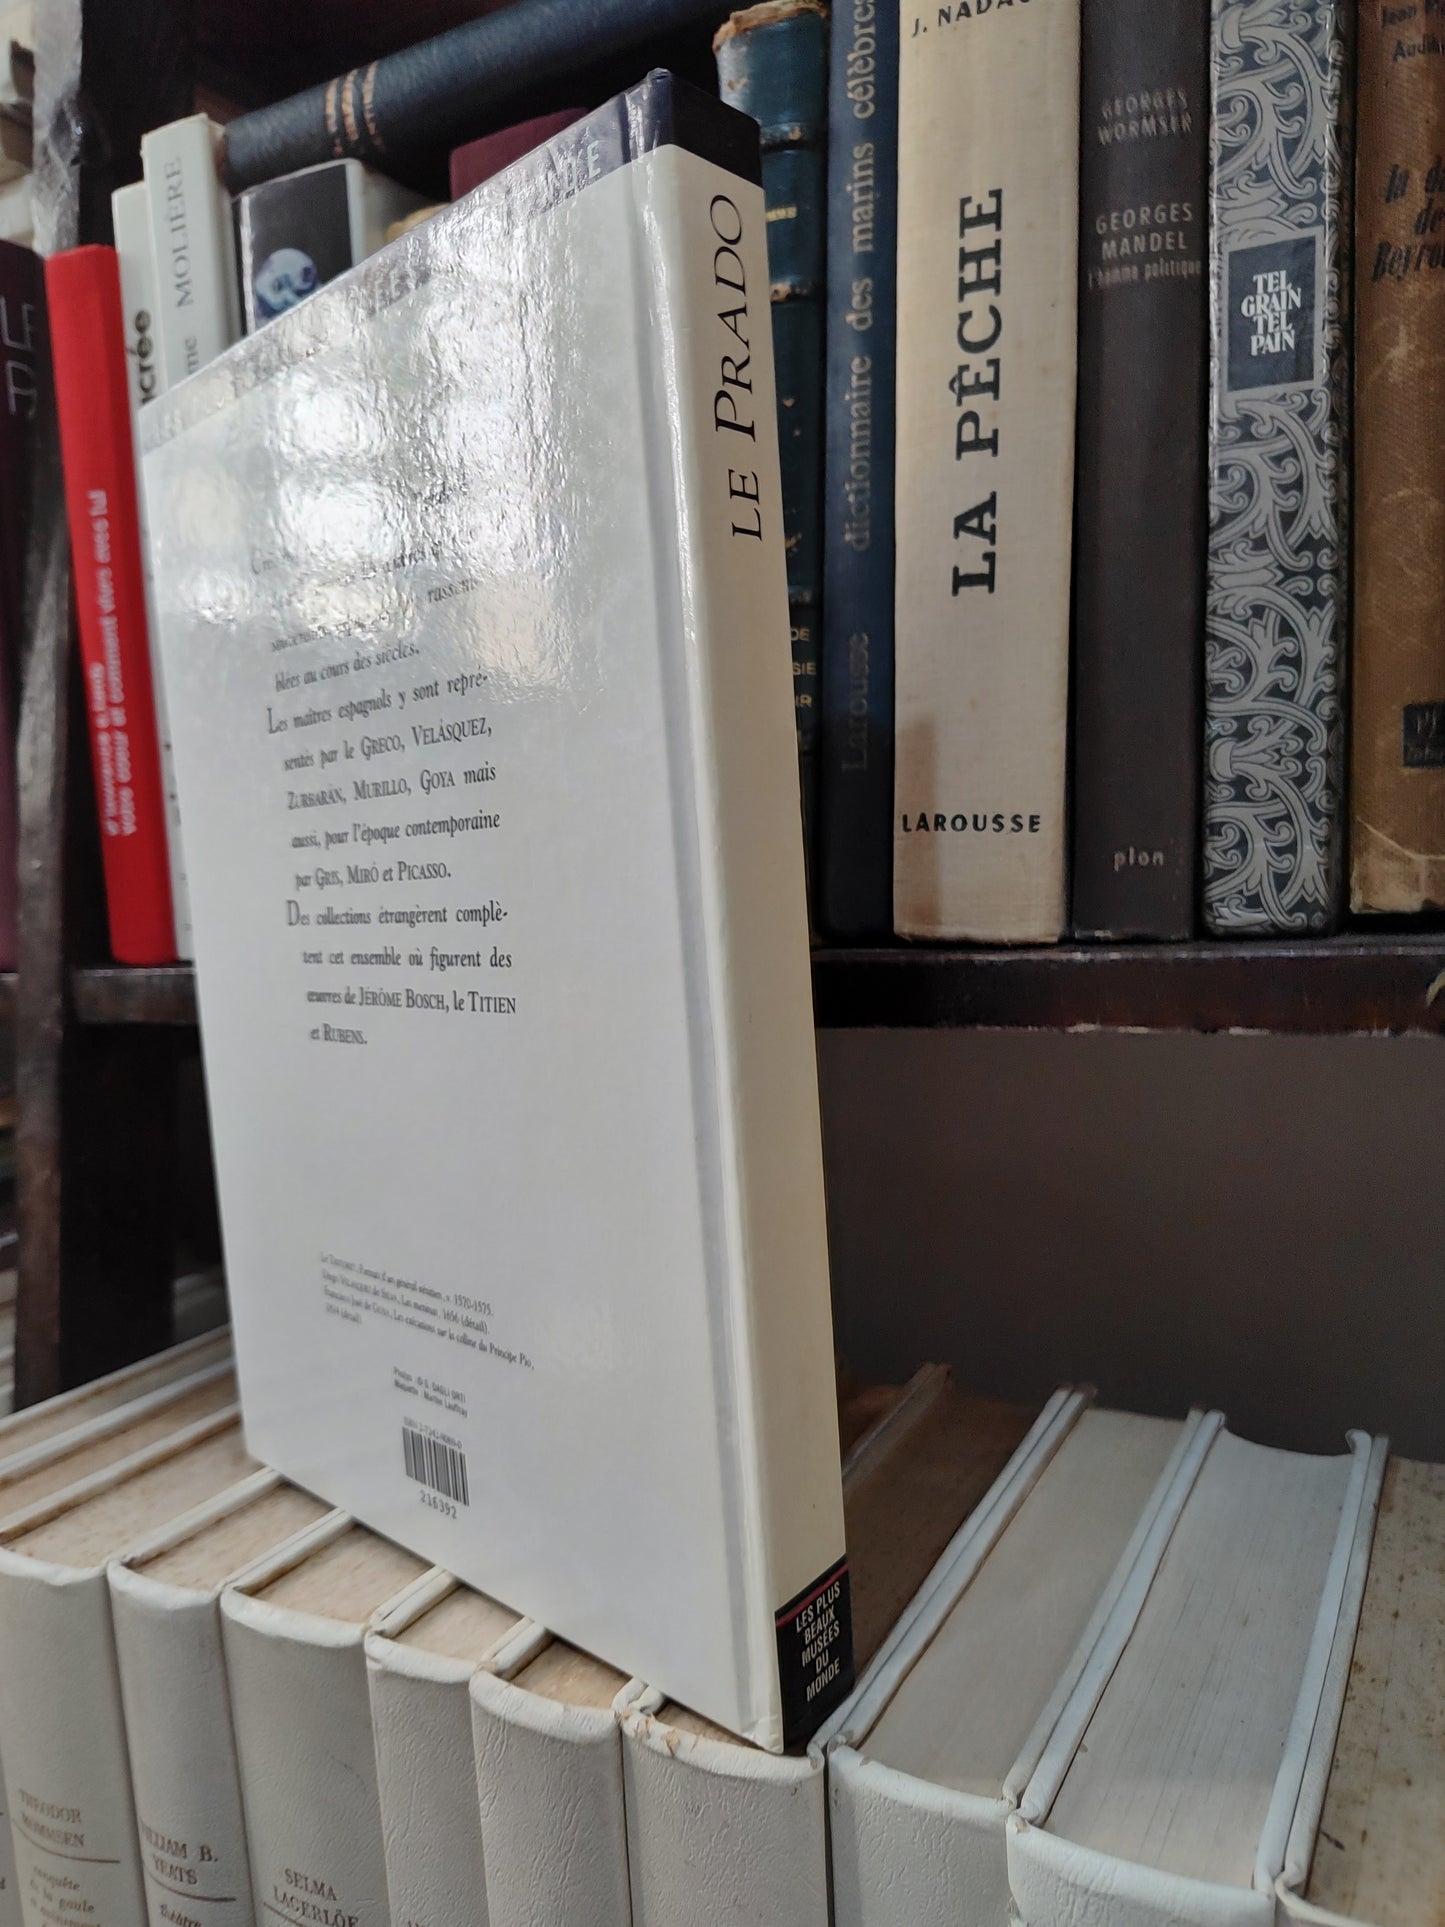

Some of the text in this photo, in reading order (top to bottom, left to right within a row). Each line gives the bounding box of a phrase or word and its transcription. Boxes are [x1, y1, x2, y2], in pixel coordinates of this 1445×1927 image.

[911, 0, 1031, 38] J. NADA
[1095, 203, 1193, 235] GEORGES
[1102, 231, 1188, 261] MANDEL
[844, 0, 876, 551] dictionnaire des marins célèbre
[1253, 270, 1292, 294] TEL
[1241, 287, 1302, 319] GRAIN
[1253, 311, 1293, 336] TEL
[1250, 330, 1296, 357] PAIN
[710, 194, 763, 542] LE PRADO
[949, 188, 1003, 597] LA PÊCHE
[303, 671, 318, 685] au
[320, 663, 350, 682] cours
[353, 652, 372, 672] des
[266, 707, 288, 735] Les
[338, 688, 392, 721] espagnols
[398, 690, 408, 710] y
[412, 681, 439, 701] sont
[447, 665, 488, 698] repré-
[320, 747, 338, 769] par
[344, 740, 355, 760] le
[353, 777, 412, 802] MURILLO,
[420, 769, 456, 795] GOYA
[463, 760, 497, 784] mais
[291, 809, 501, 850] aussi, pour l'époque contemporaine
[901, 811, 1042, 834] LAROUSSE
[1113, 846, 1165, 873] plon
[295, 873, 312, 891] par
[382, 867, 394, 883] et
[397, 861, 452, 882] PICASSO.
[286, 899, 508, 929] Des collections étrangèrent complè-
[302, 945, 513, 973] tent cet ensemble où figurent des
[344, 986, 357, 1005] de
[404, 988, 450, 1014] BOSCH,
[452, 989, 466, 1012] le
[467, 990, 517, 1015] TITIEN
[309, 1022, 368, 1045] et RUBENS.
[796, 1580, 840, 1633] LES PLUS
[804, 1605, 835, 1646] BEAUX
[801, 1620, 840, 1668] MUSÉES
[815, 1649, 829, 1674] DU
[806, 1657, 840, 1703] MONDE
[199, 1845, 218, 1863] B.
[284, 1867, 337, 1902] SELMA
